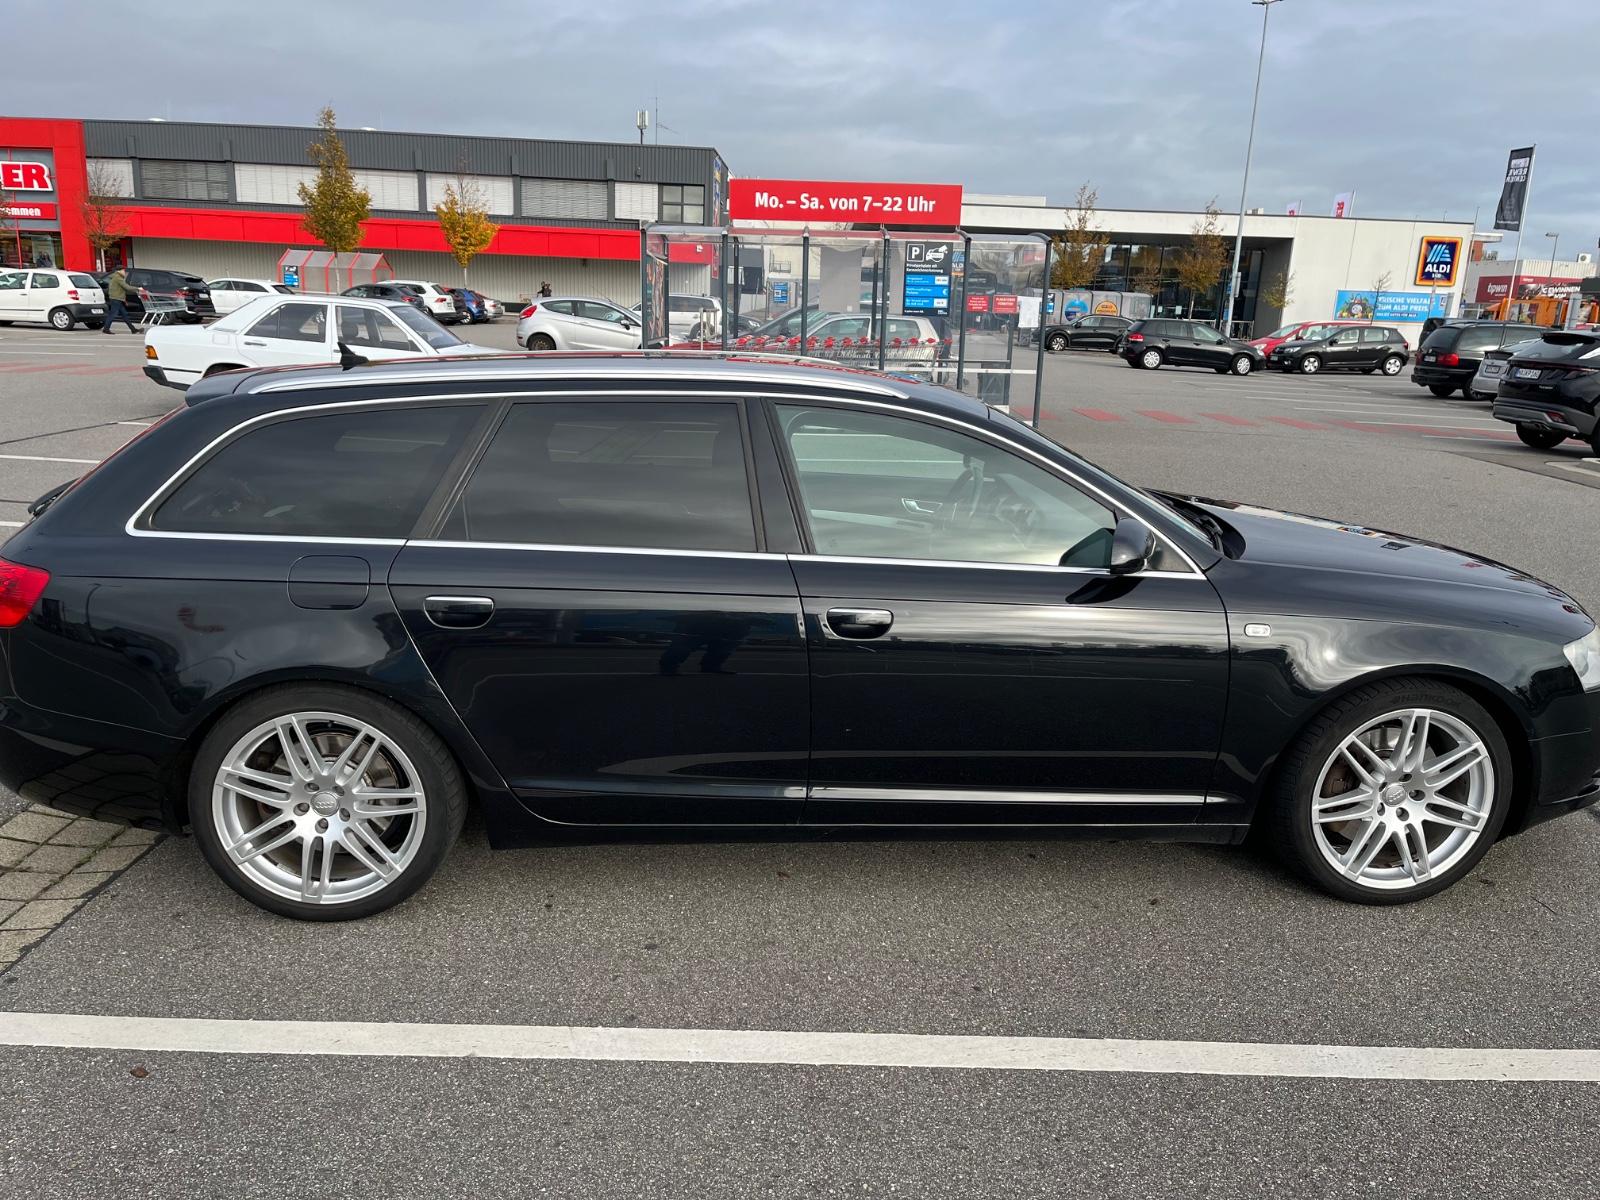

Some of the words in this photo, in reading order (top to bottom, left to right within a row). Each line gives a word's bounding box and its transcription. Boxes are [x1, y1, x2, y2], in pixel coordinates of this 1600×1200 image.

[755, 191, 784, 209] Mo.
[800, 193, 824, 210] Sa.
[829, 197, 858, 211] von
[907, 196, 936, 213] Uhr
[911, 246, 920, 259] P
[1424, 263, 1451, 273] ALDI
